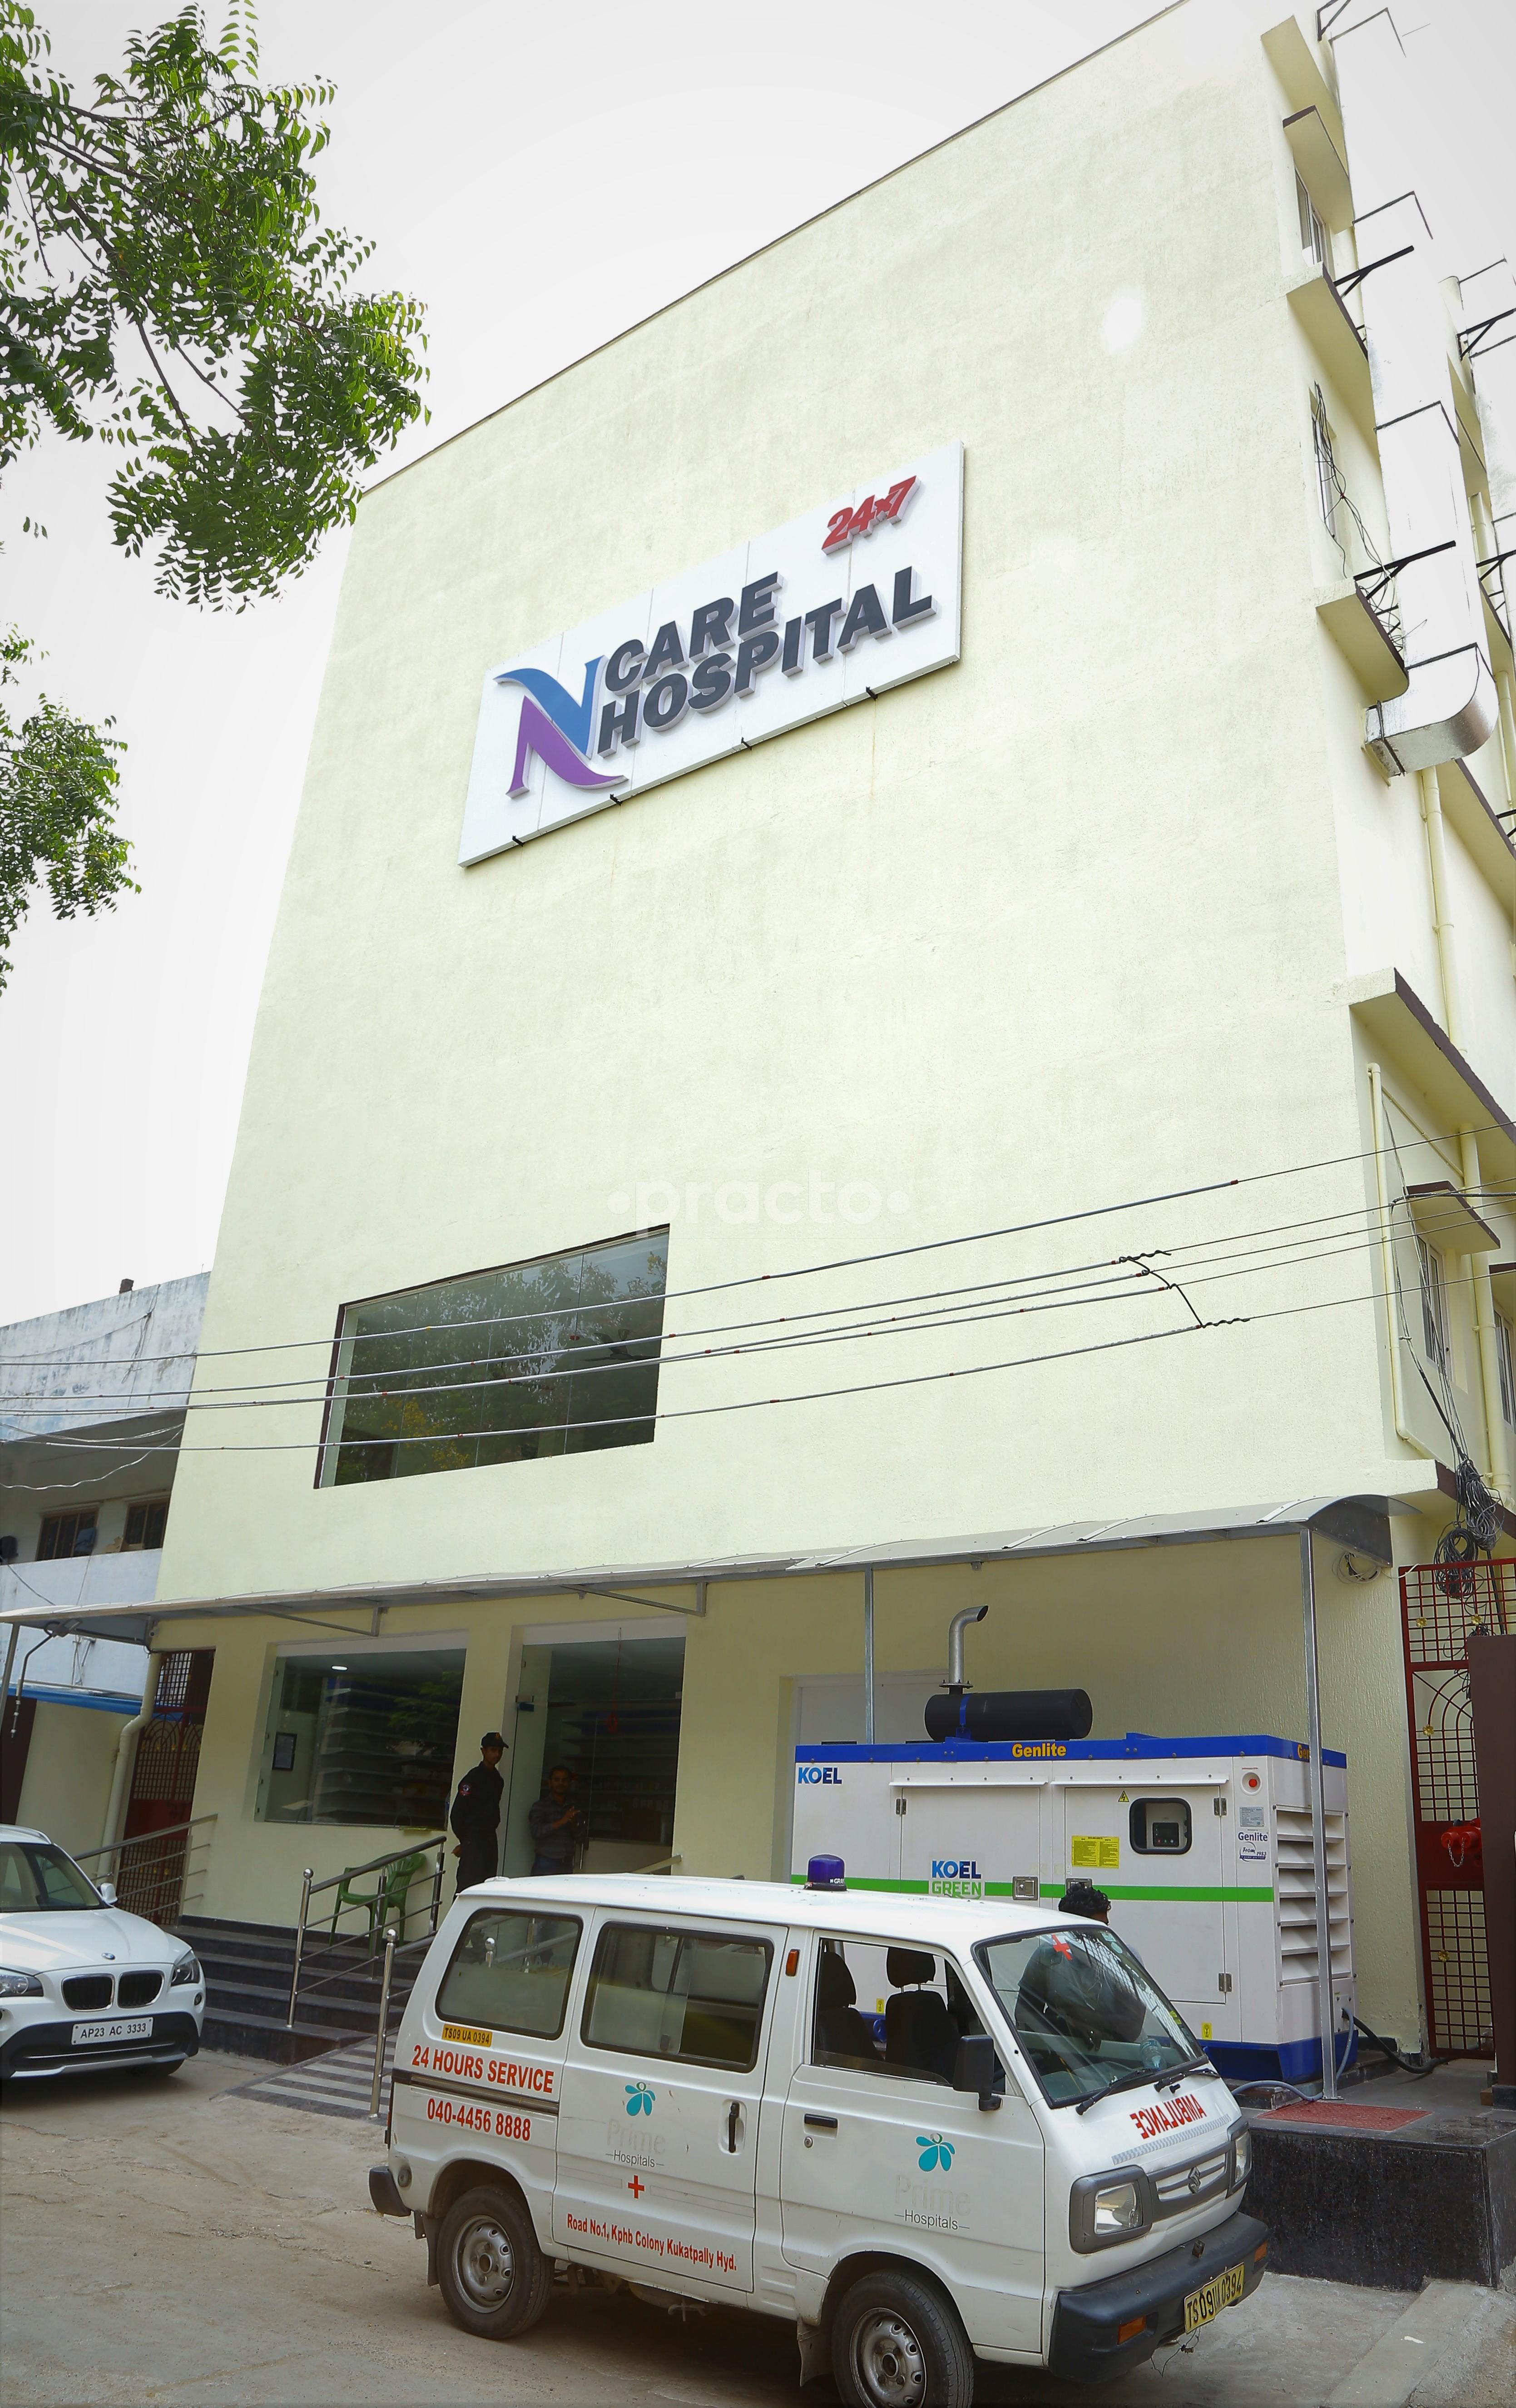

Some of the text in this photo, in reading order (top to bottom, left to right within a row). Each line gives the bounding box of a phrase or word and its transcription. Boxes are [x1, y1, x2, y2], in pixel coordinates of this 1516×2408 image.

[605, 571, 784, 695] CARE
[597, 566, 936, 758] HOSPITAL
[1012, 1743, 1067, 1758] Genlite
[798, 1767, 842, 1784] KOEL
[1238, 1832, 1268, 1842] Genlite
[932, 1860, 981, 1879] KOEL
[932, 1881, 981, 1896] GREEN
[80, 2023, 146, 2039] AP23 AC 3333
[445, 2027, 490, 2044] TS09 UA 0394
[412, 2044, 554, 2094] 24 HOURS SERVICE
[427, 2098, 531, 2141] 040-4456 8888
[613, 2150, 655, 2168] Hospitals
[904, 2209, 958, 2230] Hospitals
[567, 2213, 737, 2273] Road No.1, Kphb Colony Kukatpally Hyd.
